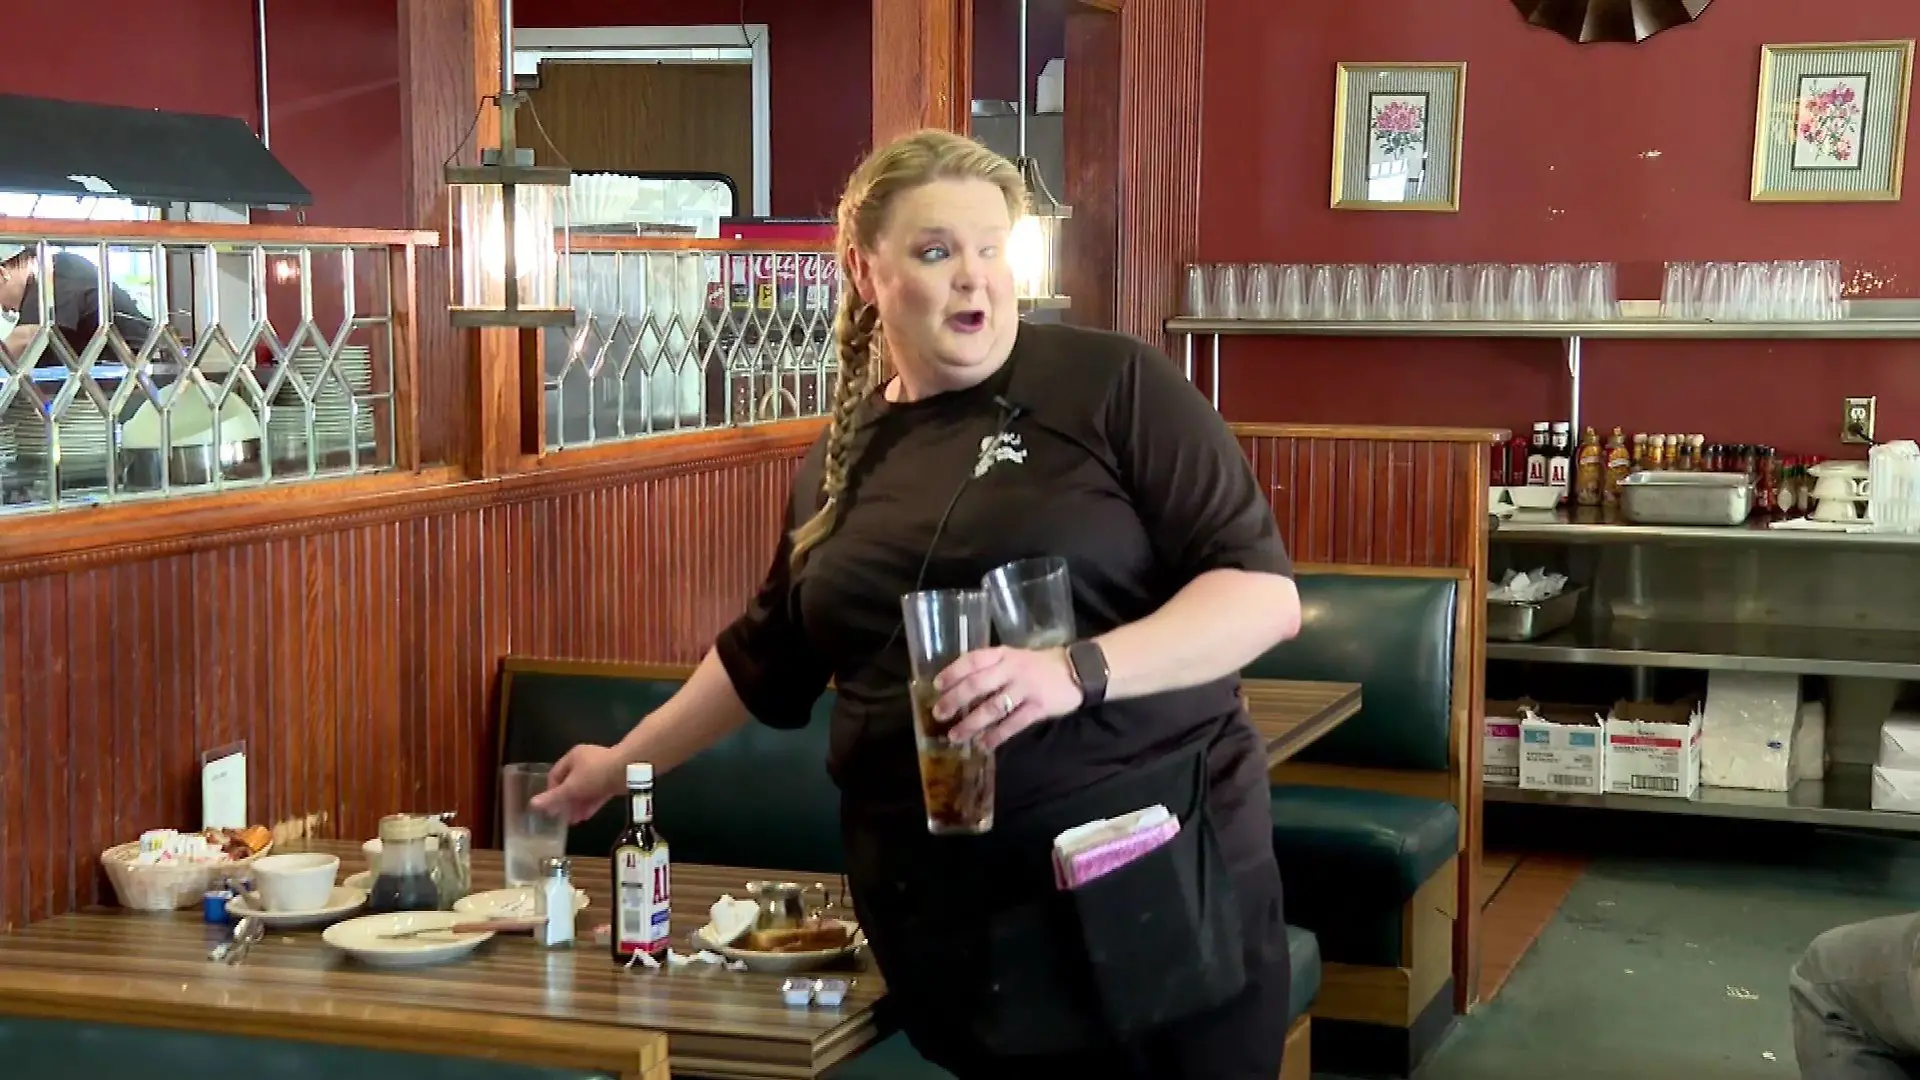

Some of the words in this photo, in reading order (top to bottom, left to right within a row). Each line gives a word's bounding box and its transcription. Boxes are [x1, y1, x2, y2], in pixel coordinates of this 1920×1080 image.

[1530, 462, 1544, 479] A1
[1551, 465, 1565, 481] A1
[653, 864, 669, 904] A1
